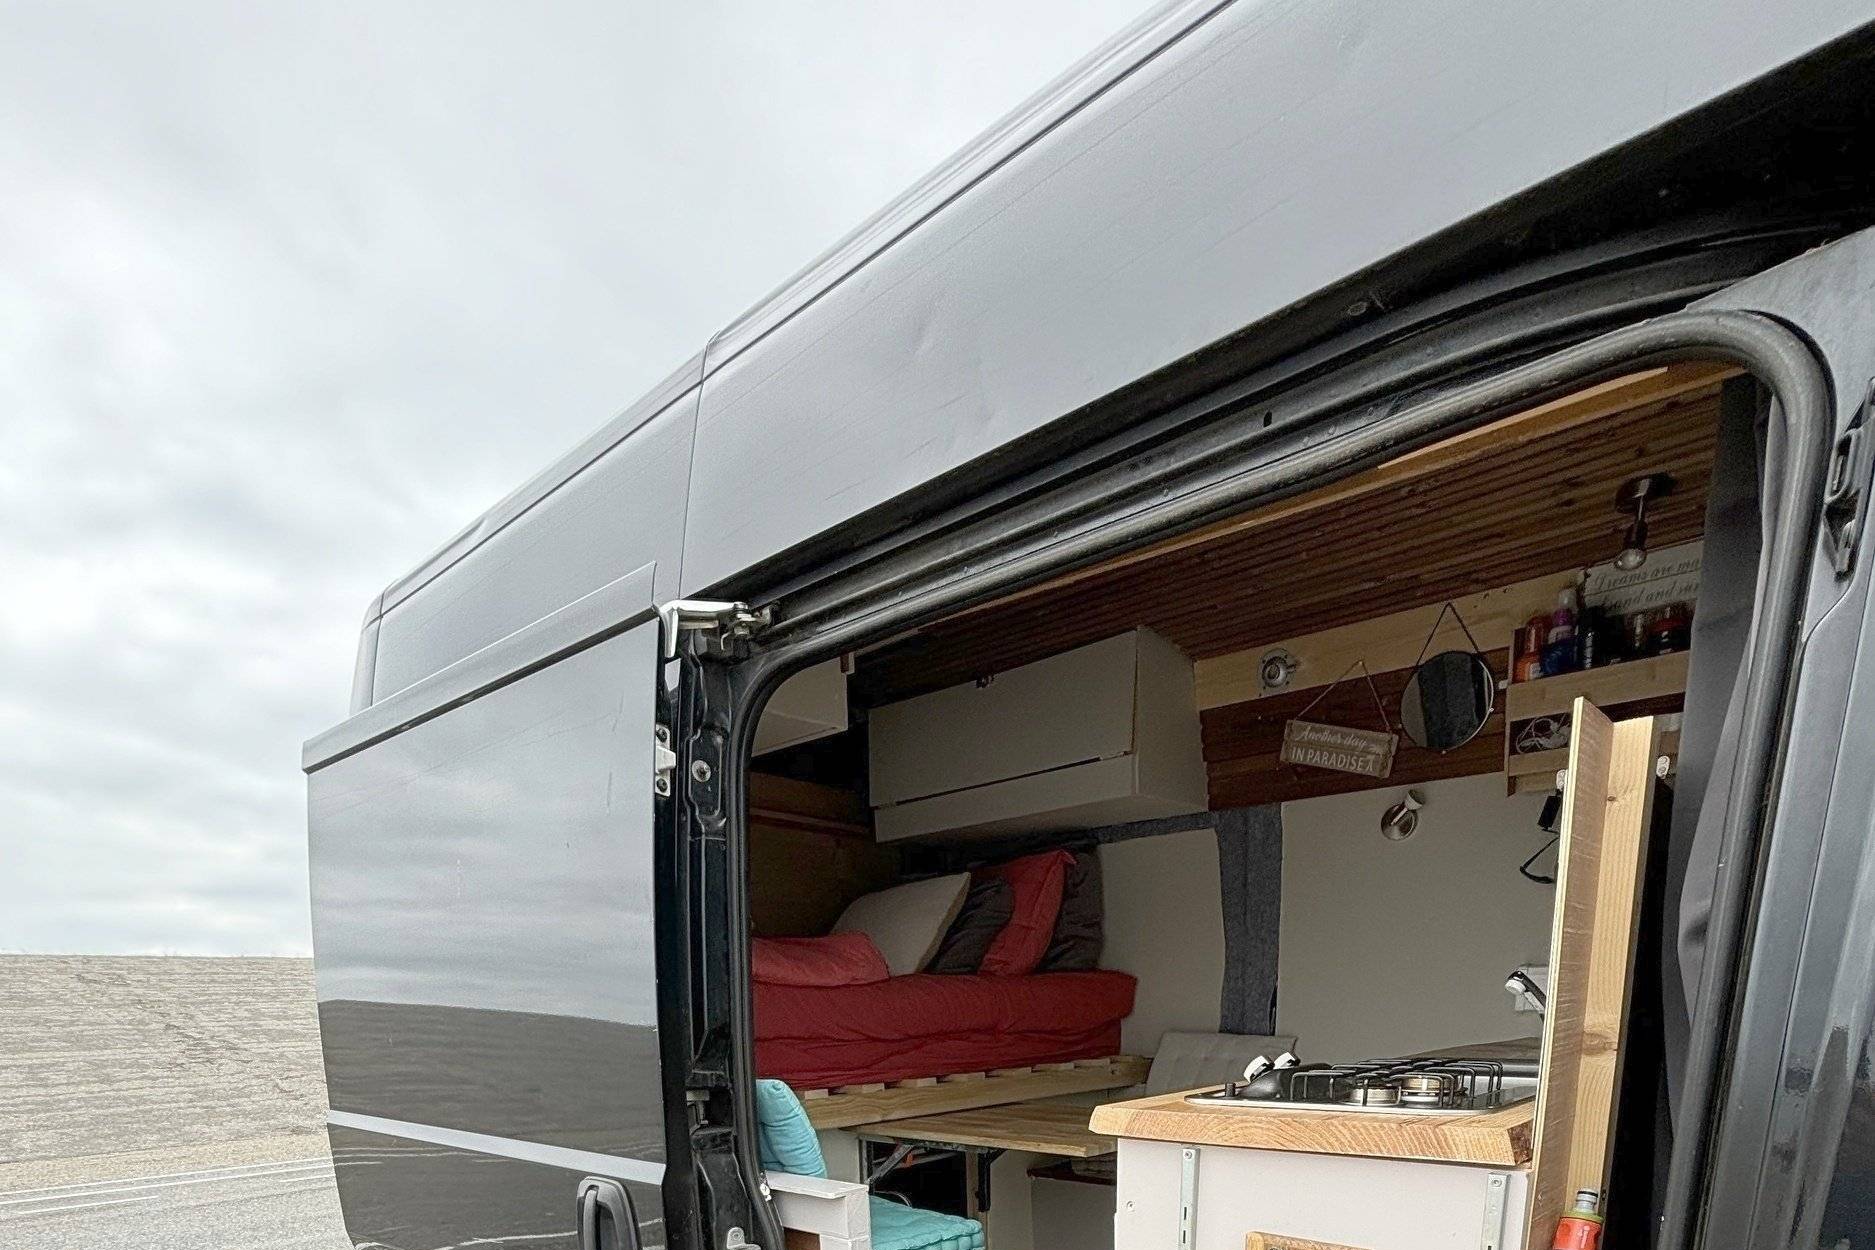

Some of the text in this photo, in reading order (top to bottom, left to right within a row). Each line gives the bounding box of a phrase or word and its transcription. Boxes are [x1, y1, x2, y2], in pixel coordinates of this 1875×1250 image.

[1646, 580, 1678, 600] and
[1294, 725, 1368, 751] Another day
[1291, 746, 1365, 772] IN PARADISE
